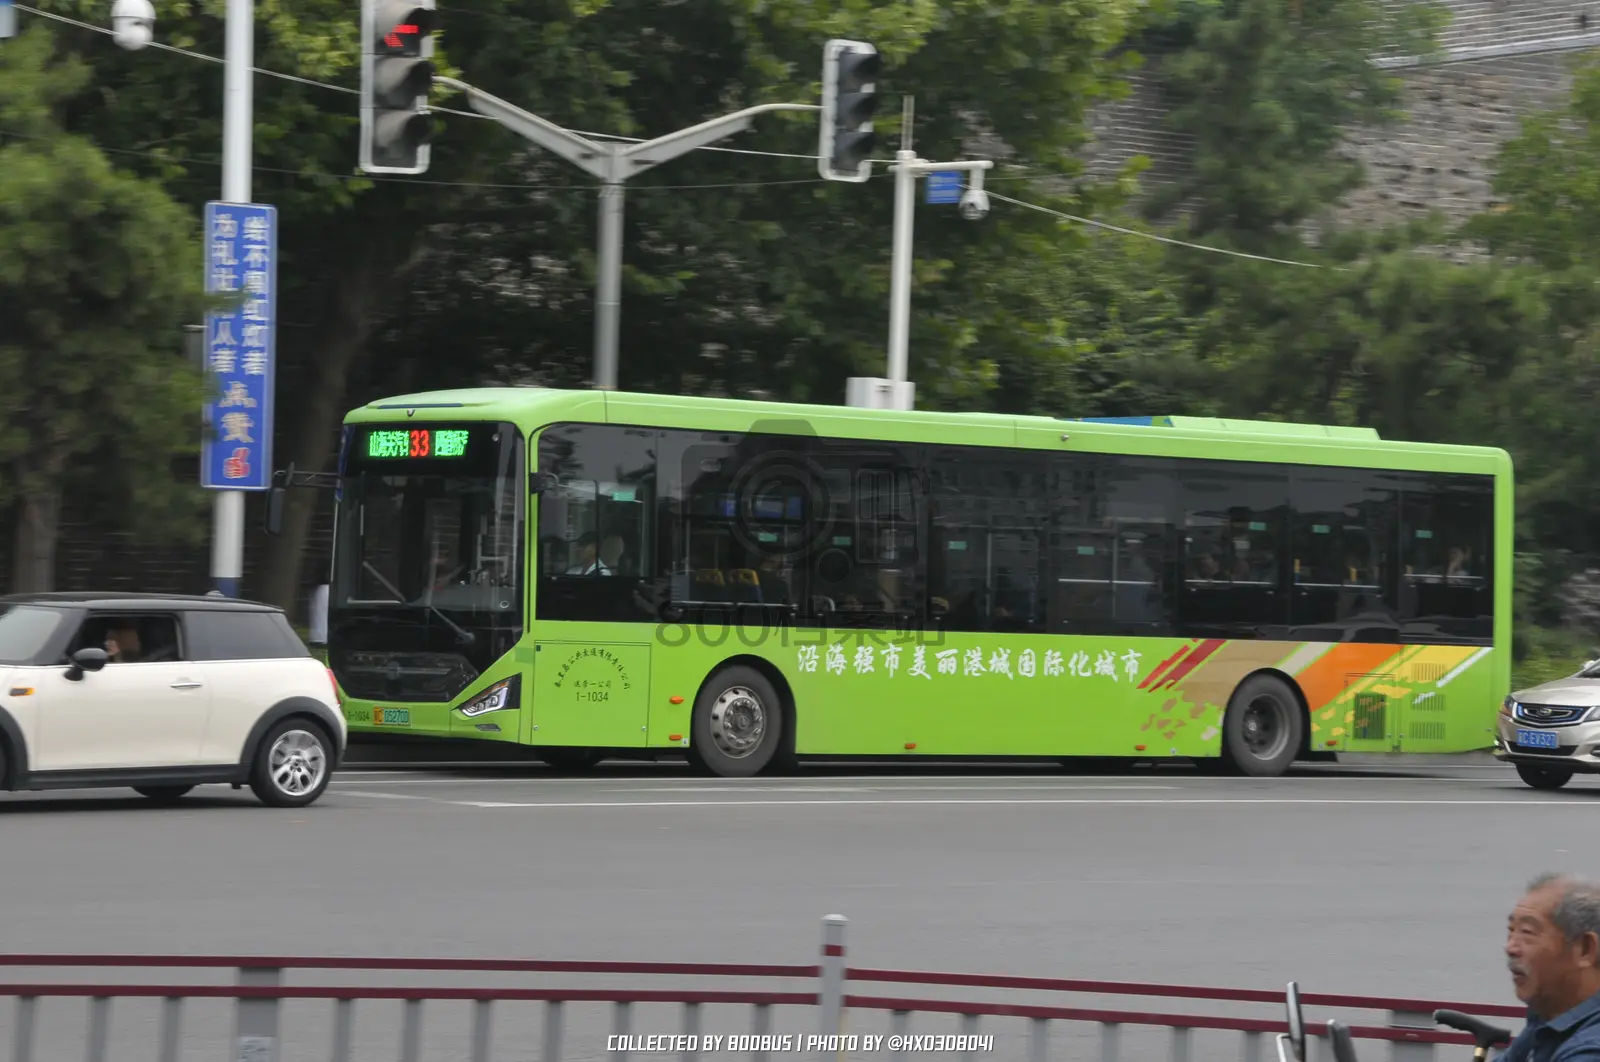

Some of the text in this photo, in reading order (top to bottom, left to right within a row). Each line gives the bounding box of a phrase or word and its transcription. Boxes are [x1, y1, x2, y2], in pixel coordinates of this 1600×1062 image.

[211, 213, 239, 373] 为礼让人者
[410, 430, 429, 457] 33
[797, 643, 1142, 683] 沿海强市美丽港城国际化城市
[576, 691, 609, 702] 1-1034
